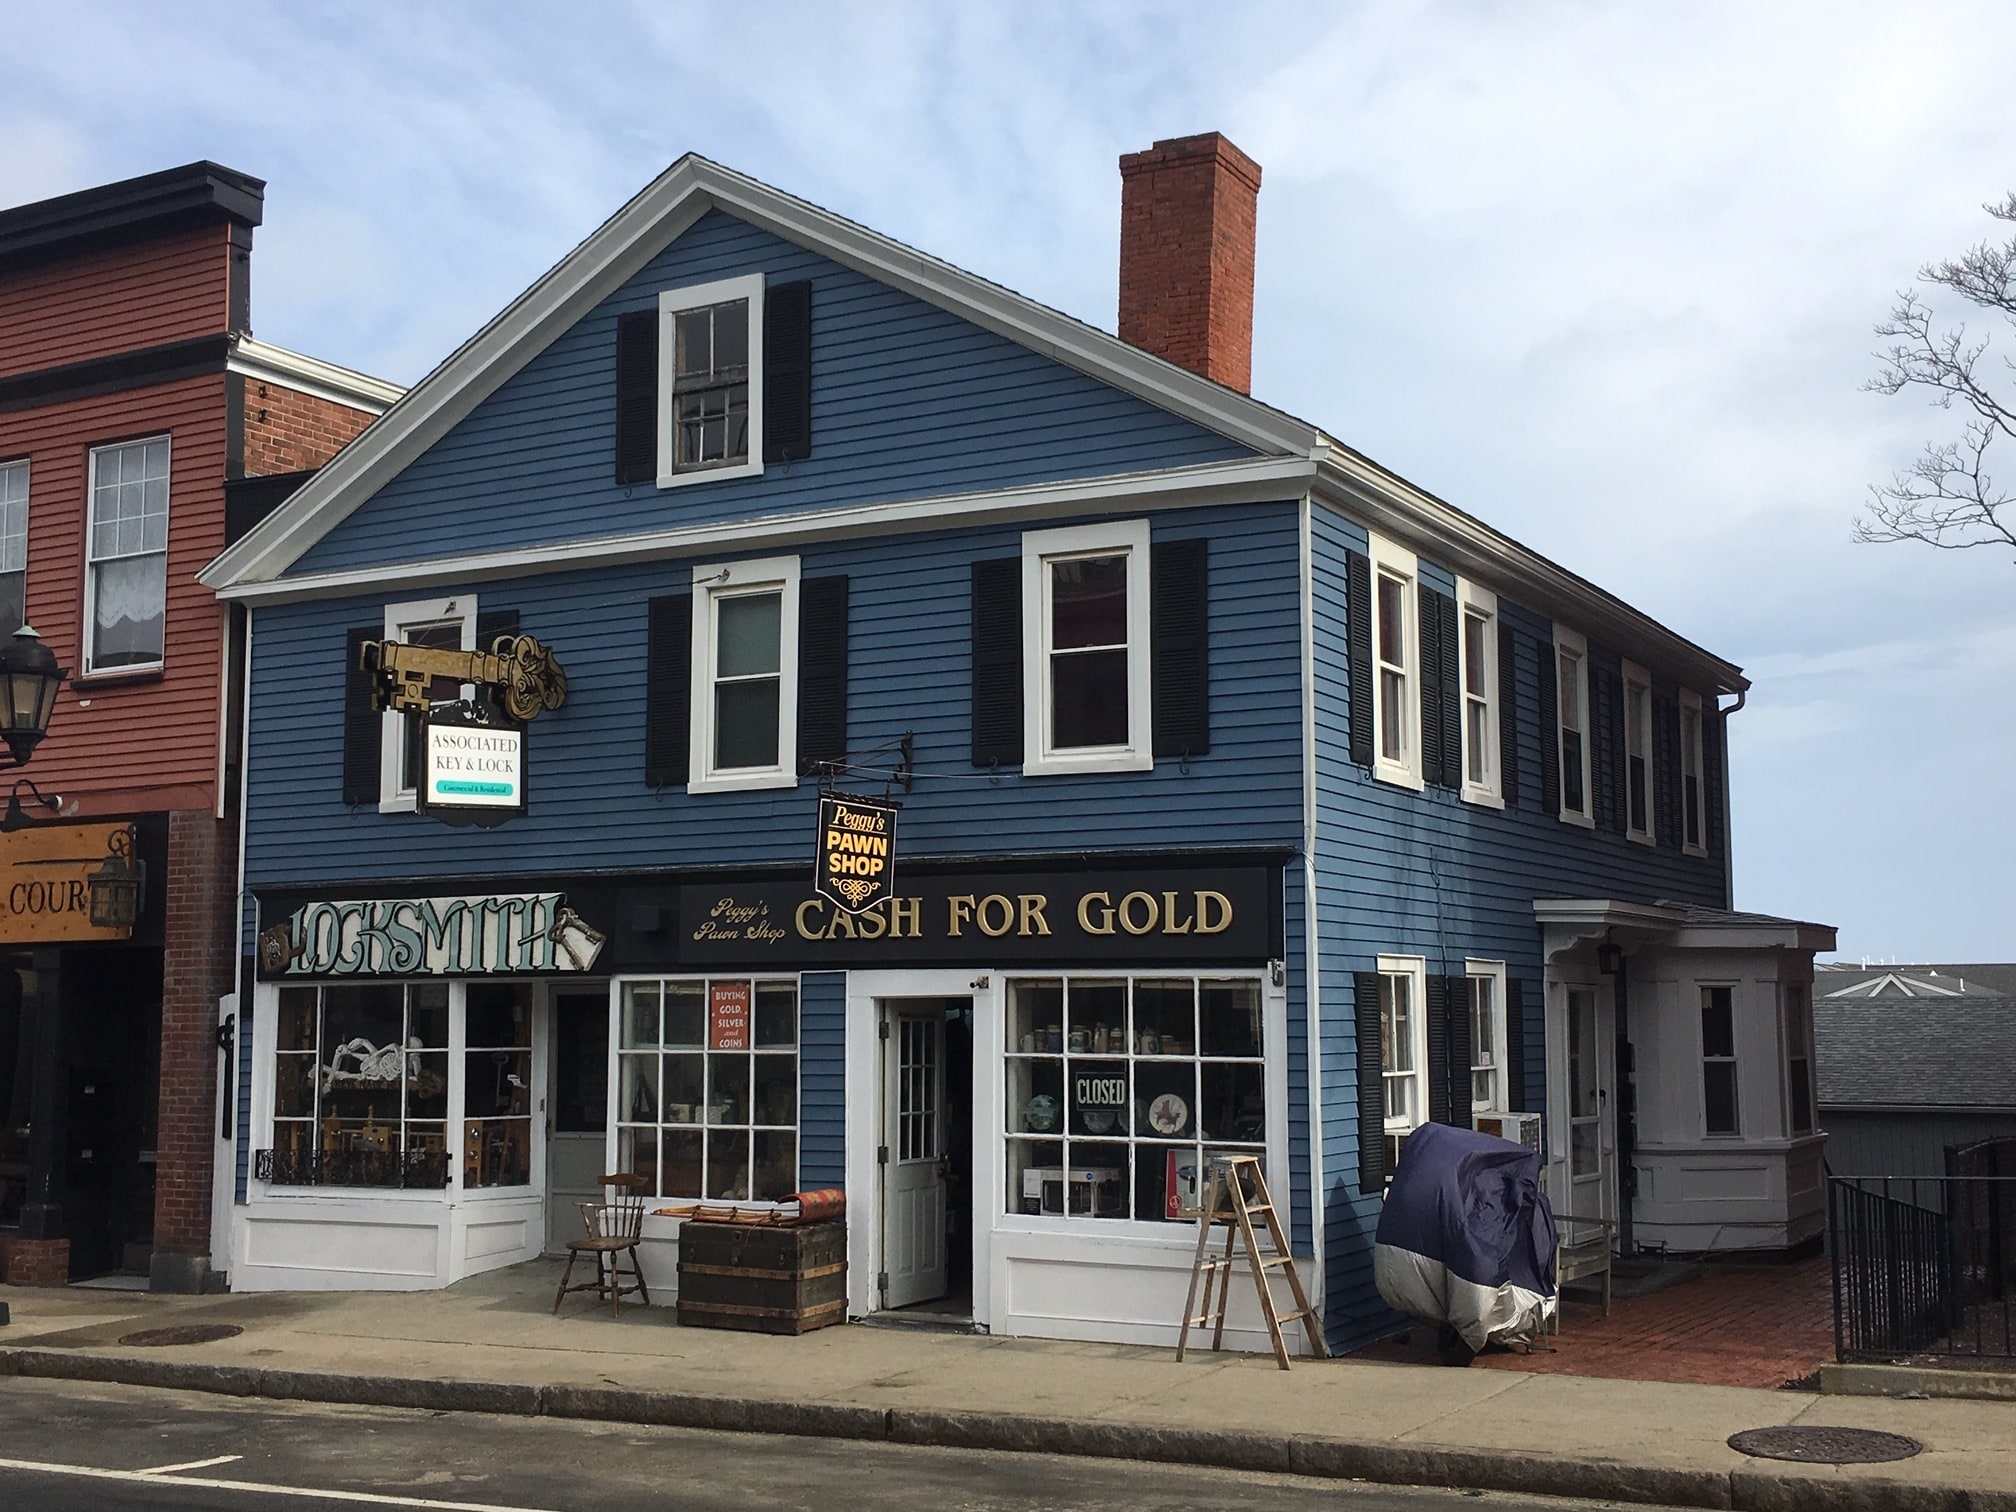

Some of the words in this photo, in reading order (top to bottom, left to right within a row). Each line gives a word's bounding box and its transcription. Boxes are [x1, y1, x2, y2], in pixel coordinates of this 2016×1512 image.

[432, 733, 518, 752] ASSOCIATED
[436, 756, 462, 770] KEY
[466, 758, 474, 771] &
[478, 758, 514, 773] LOCK
[832, 805, 885, 832] Peggy's
[827, 830, 888, 857] PAWN
[829, 852, 884, 877] SHOP
[9, 880, 92, 915] COUR
[710, 897, 770, 924] Peggy's
[795, 897, 923, 940] CASH
[947, 894, 1052, 937] FOR
[1077, 890, 1234, 935] GOLD
[285, 895, 563, 976] LOCKSMITH
[693, 920, 740, 941] Pawn
[743, 919, 787, 945] Shop
[715, 991, 746, 1001] BUYING
[719, 1039, 742, 1048] COINS
[1077, 1079, 1125, 1105] CLOSED
